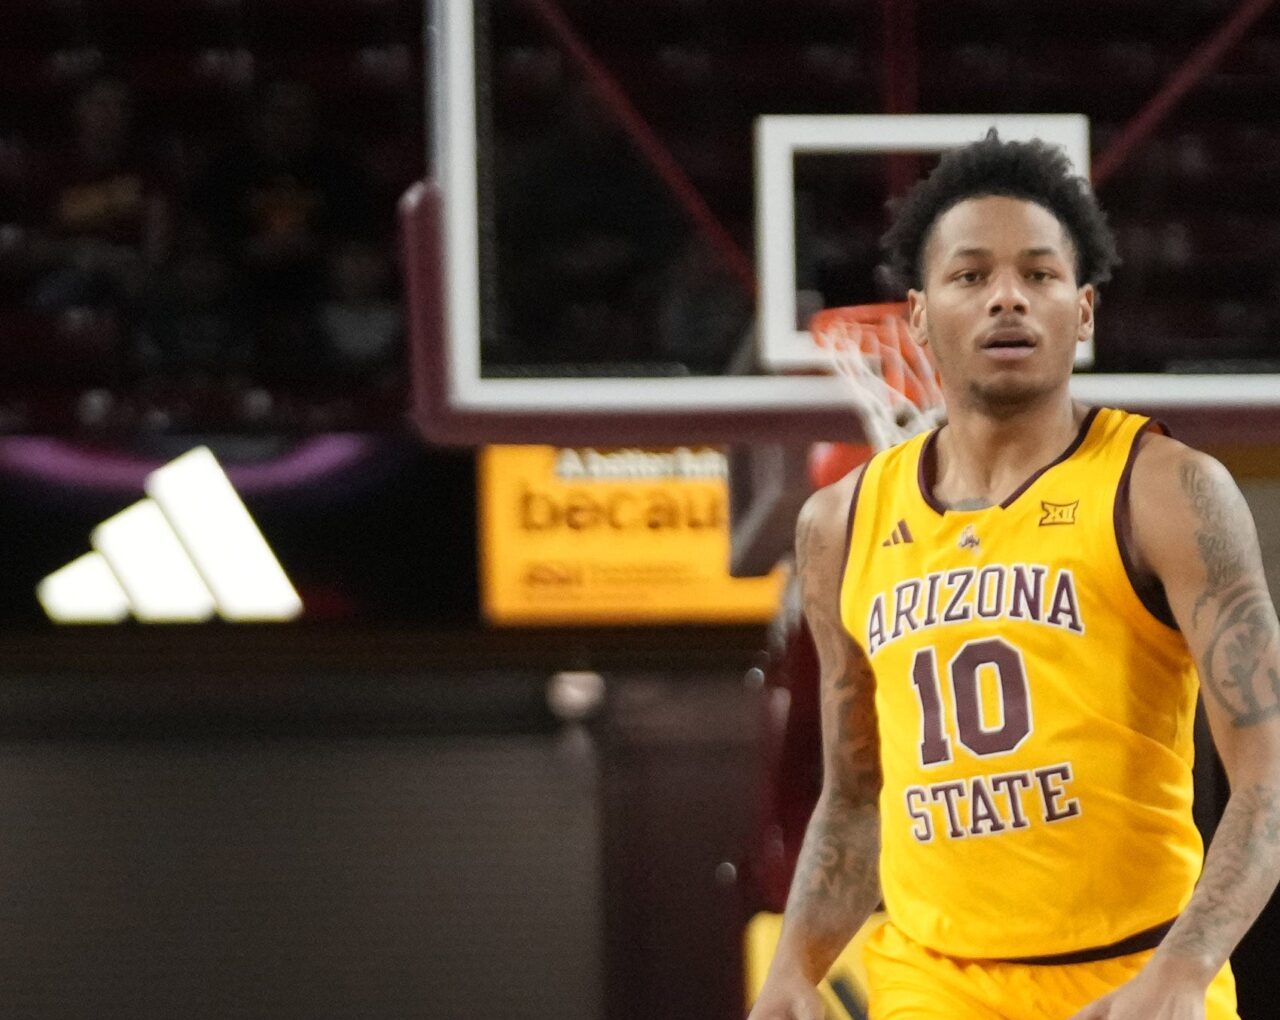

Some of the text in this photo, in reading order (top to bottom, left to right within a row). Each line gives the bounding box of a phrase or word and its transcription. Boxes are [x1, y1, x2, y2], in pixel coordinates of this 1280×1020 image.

[868, 564, 1085, 656] ARIZONA
[911, 635, 1034, 771] 10
[905, 762, 1081, 842] STATE
